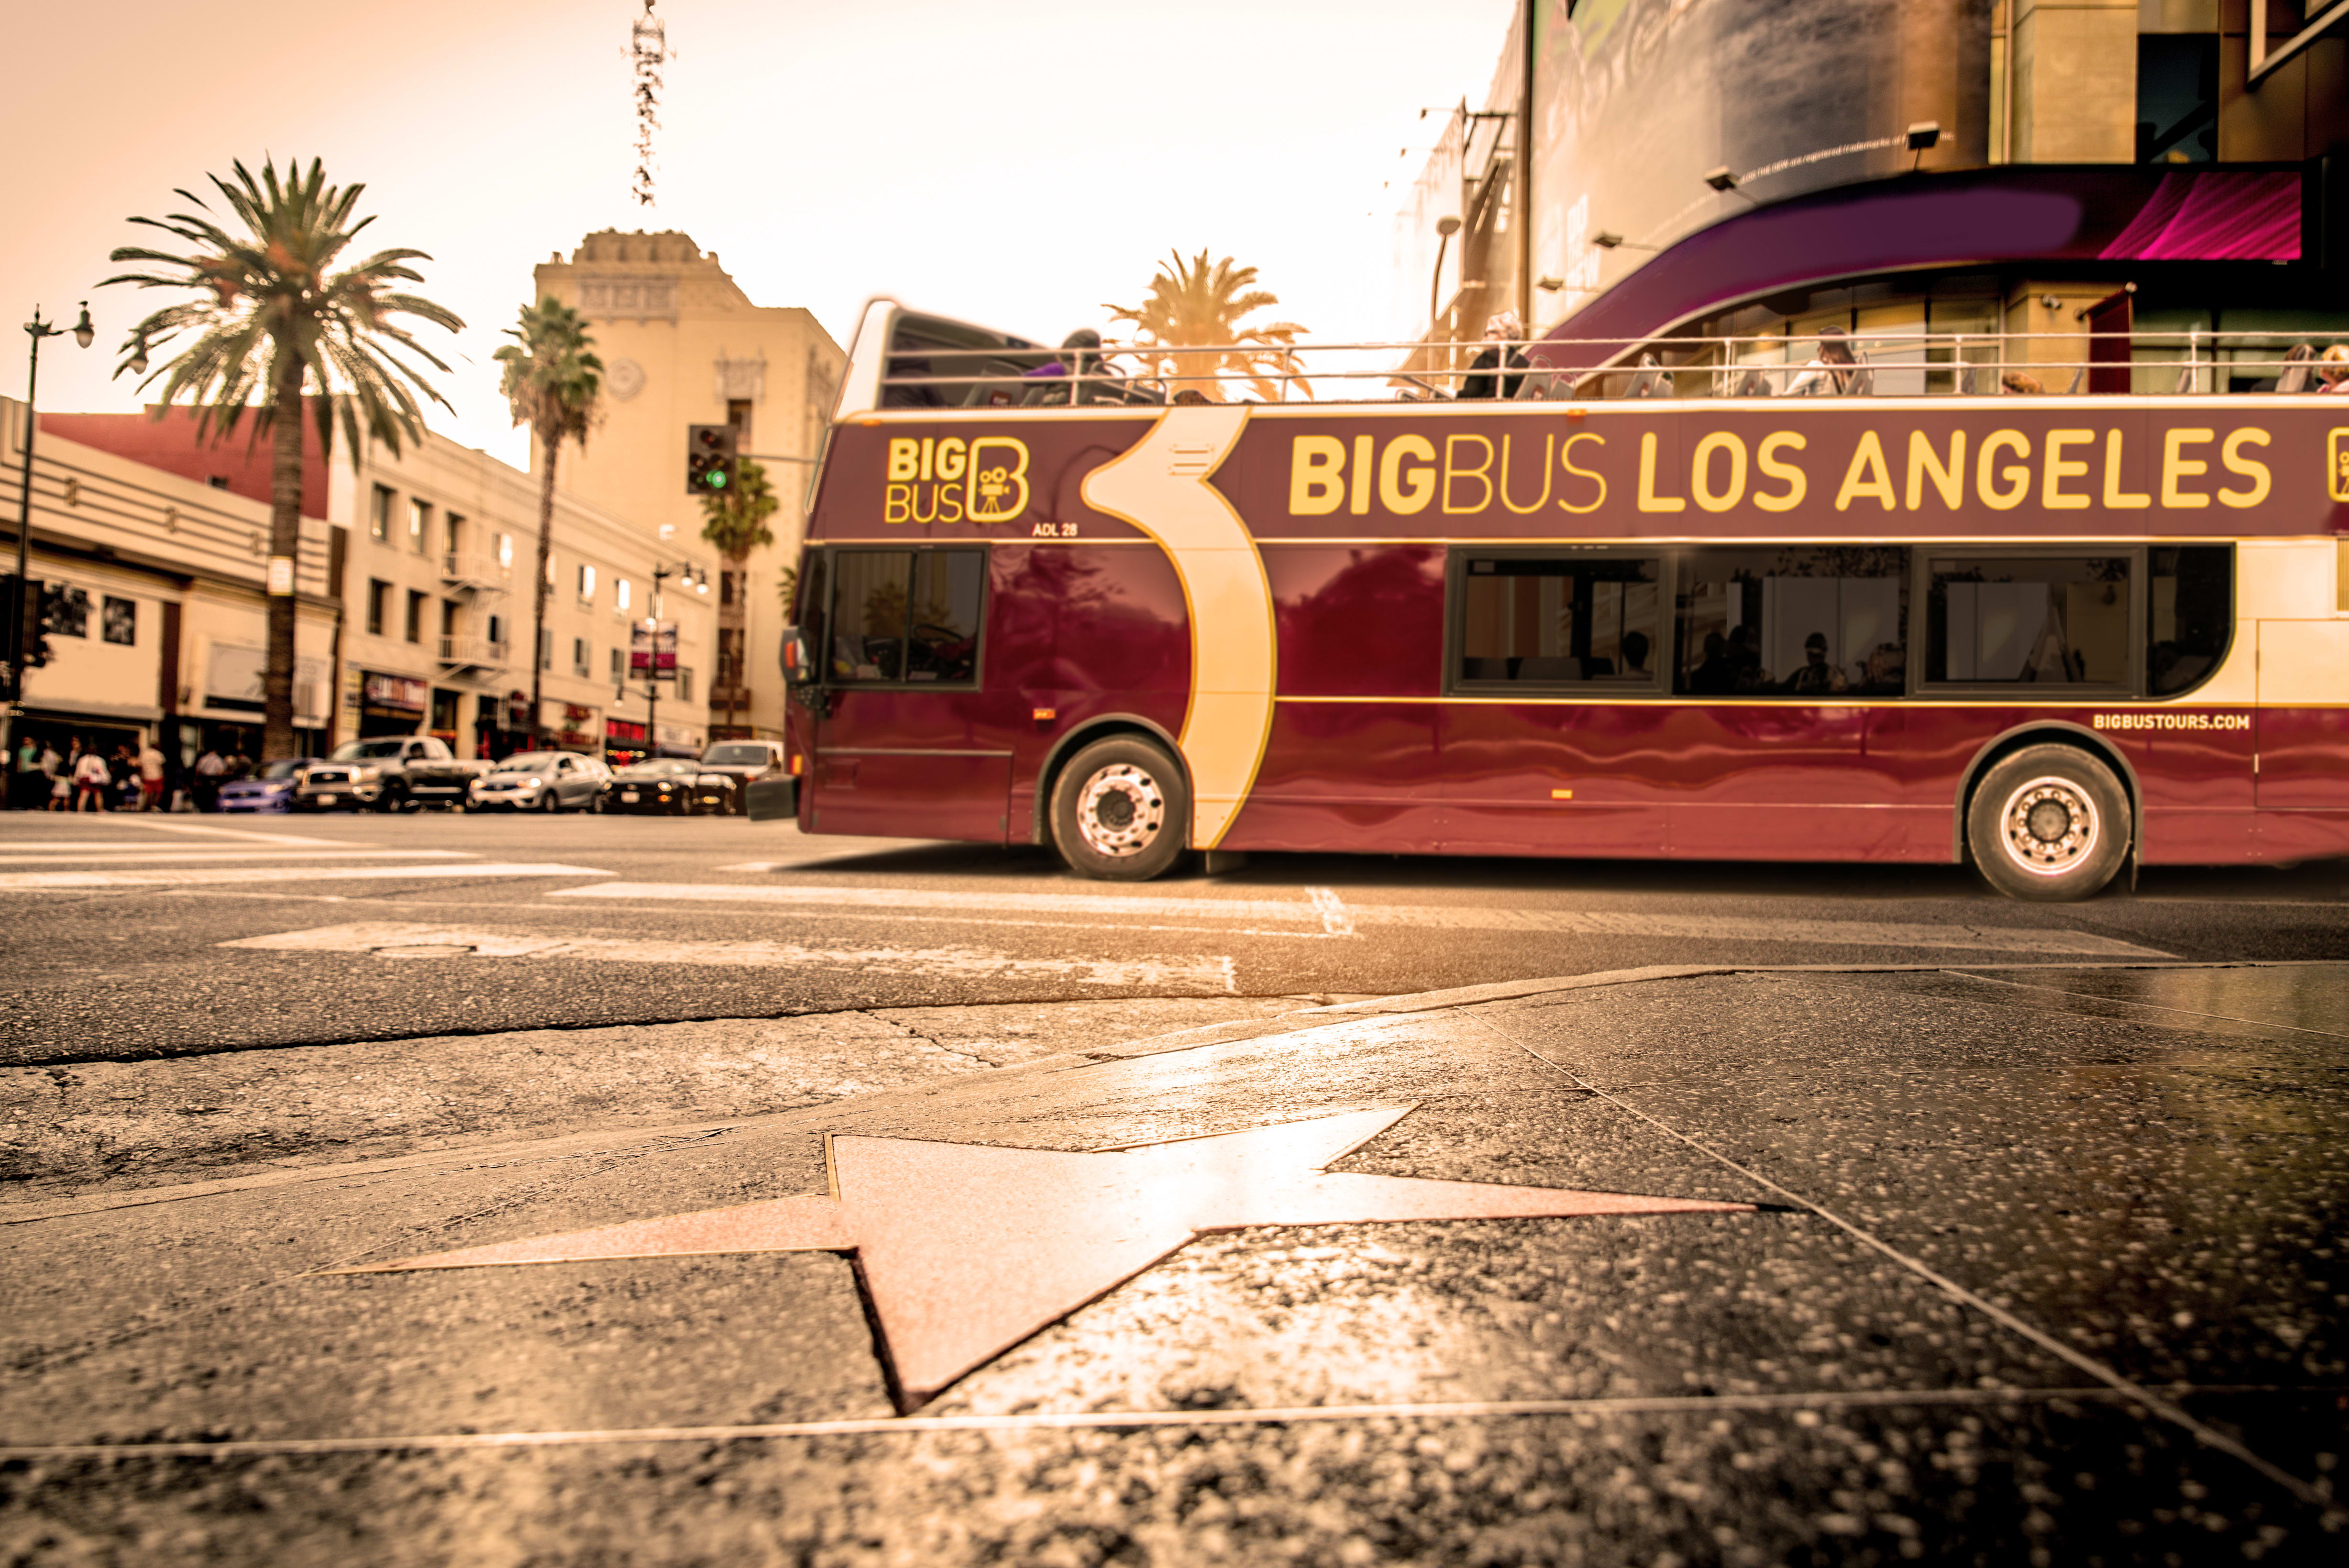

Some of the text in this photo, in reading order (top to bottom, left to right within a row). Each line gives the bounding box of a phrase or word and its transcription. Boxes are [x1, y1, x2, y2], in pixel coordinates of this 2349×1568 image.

[1803, 144, 1842, 164] registered
[1842, 136, 1891, 154] trademarks
[887, 436, 967, 482] BIG
[1638, 431, 1807, 513] LOS
[1834, 427, 2272, 511] ANGELES
[884, 483, 963, 524] BUS
[1031, 522, 1078, 537] ADL 28
[2093, 714, 2250, 730] BIGBUSTOURS.COM
